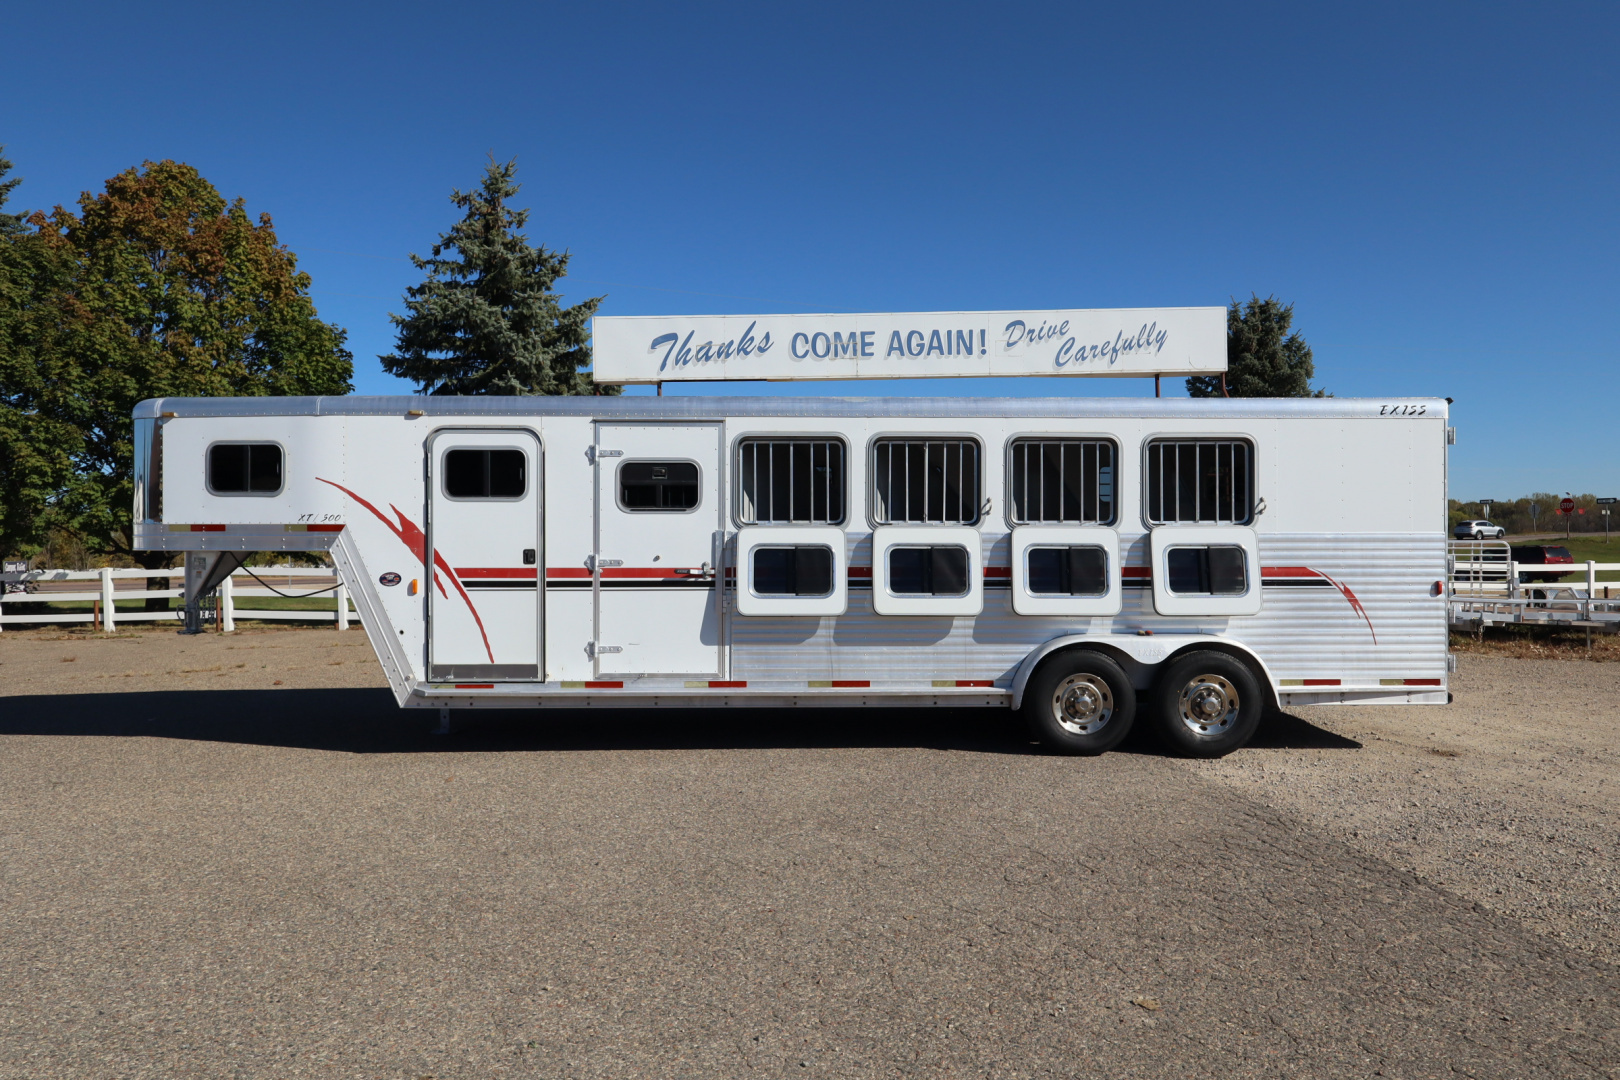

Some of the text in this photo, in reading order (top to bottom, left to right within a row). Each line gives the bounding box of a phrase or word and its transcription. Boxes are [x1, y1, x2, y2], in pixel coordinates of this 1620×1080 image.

[650, 320, 987, 372] Thanks COME AGAIN!
[1004, 319, 1070, 348] Drive
[1054, 320, 1168, 368] Carefully
[1380, 404, 1426, 416] EXISS
